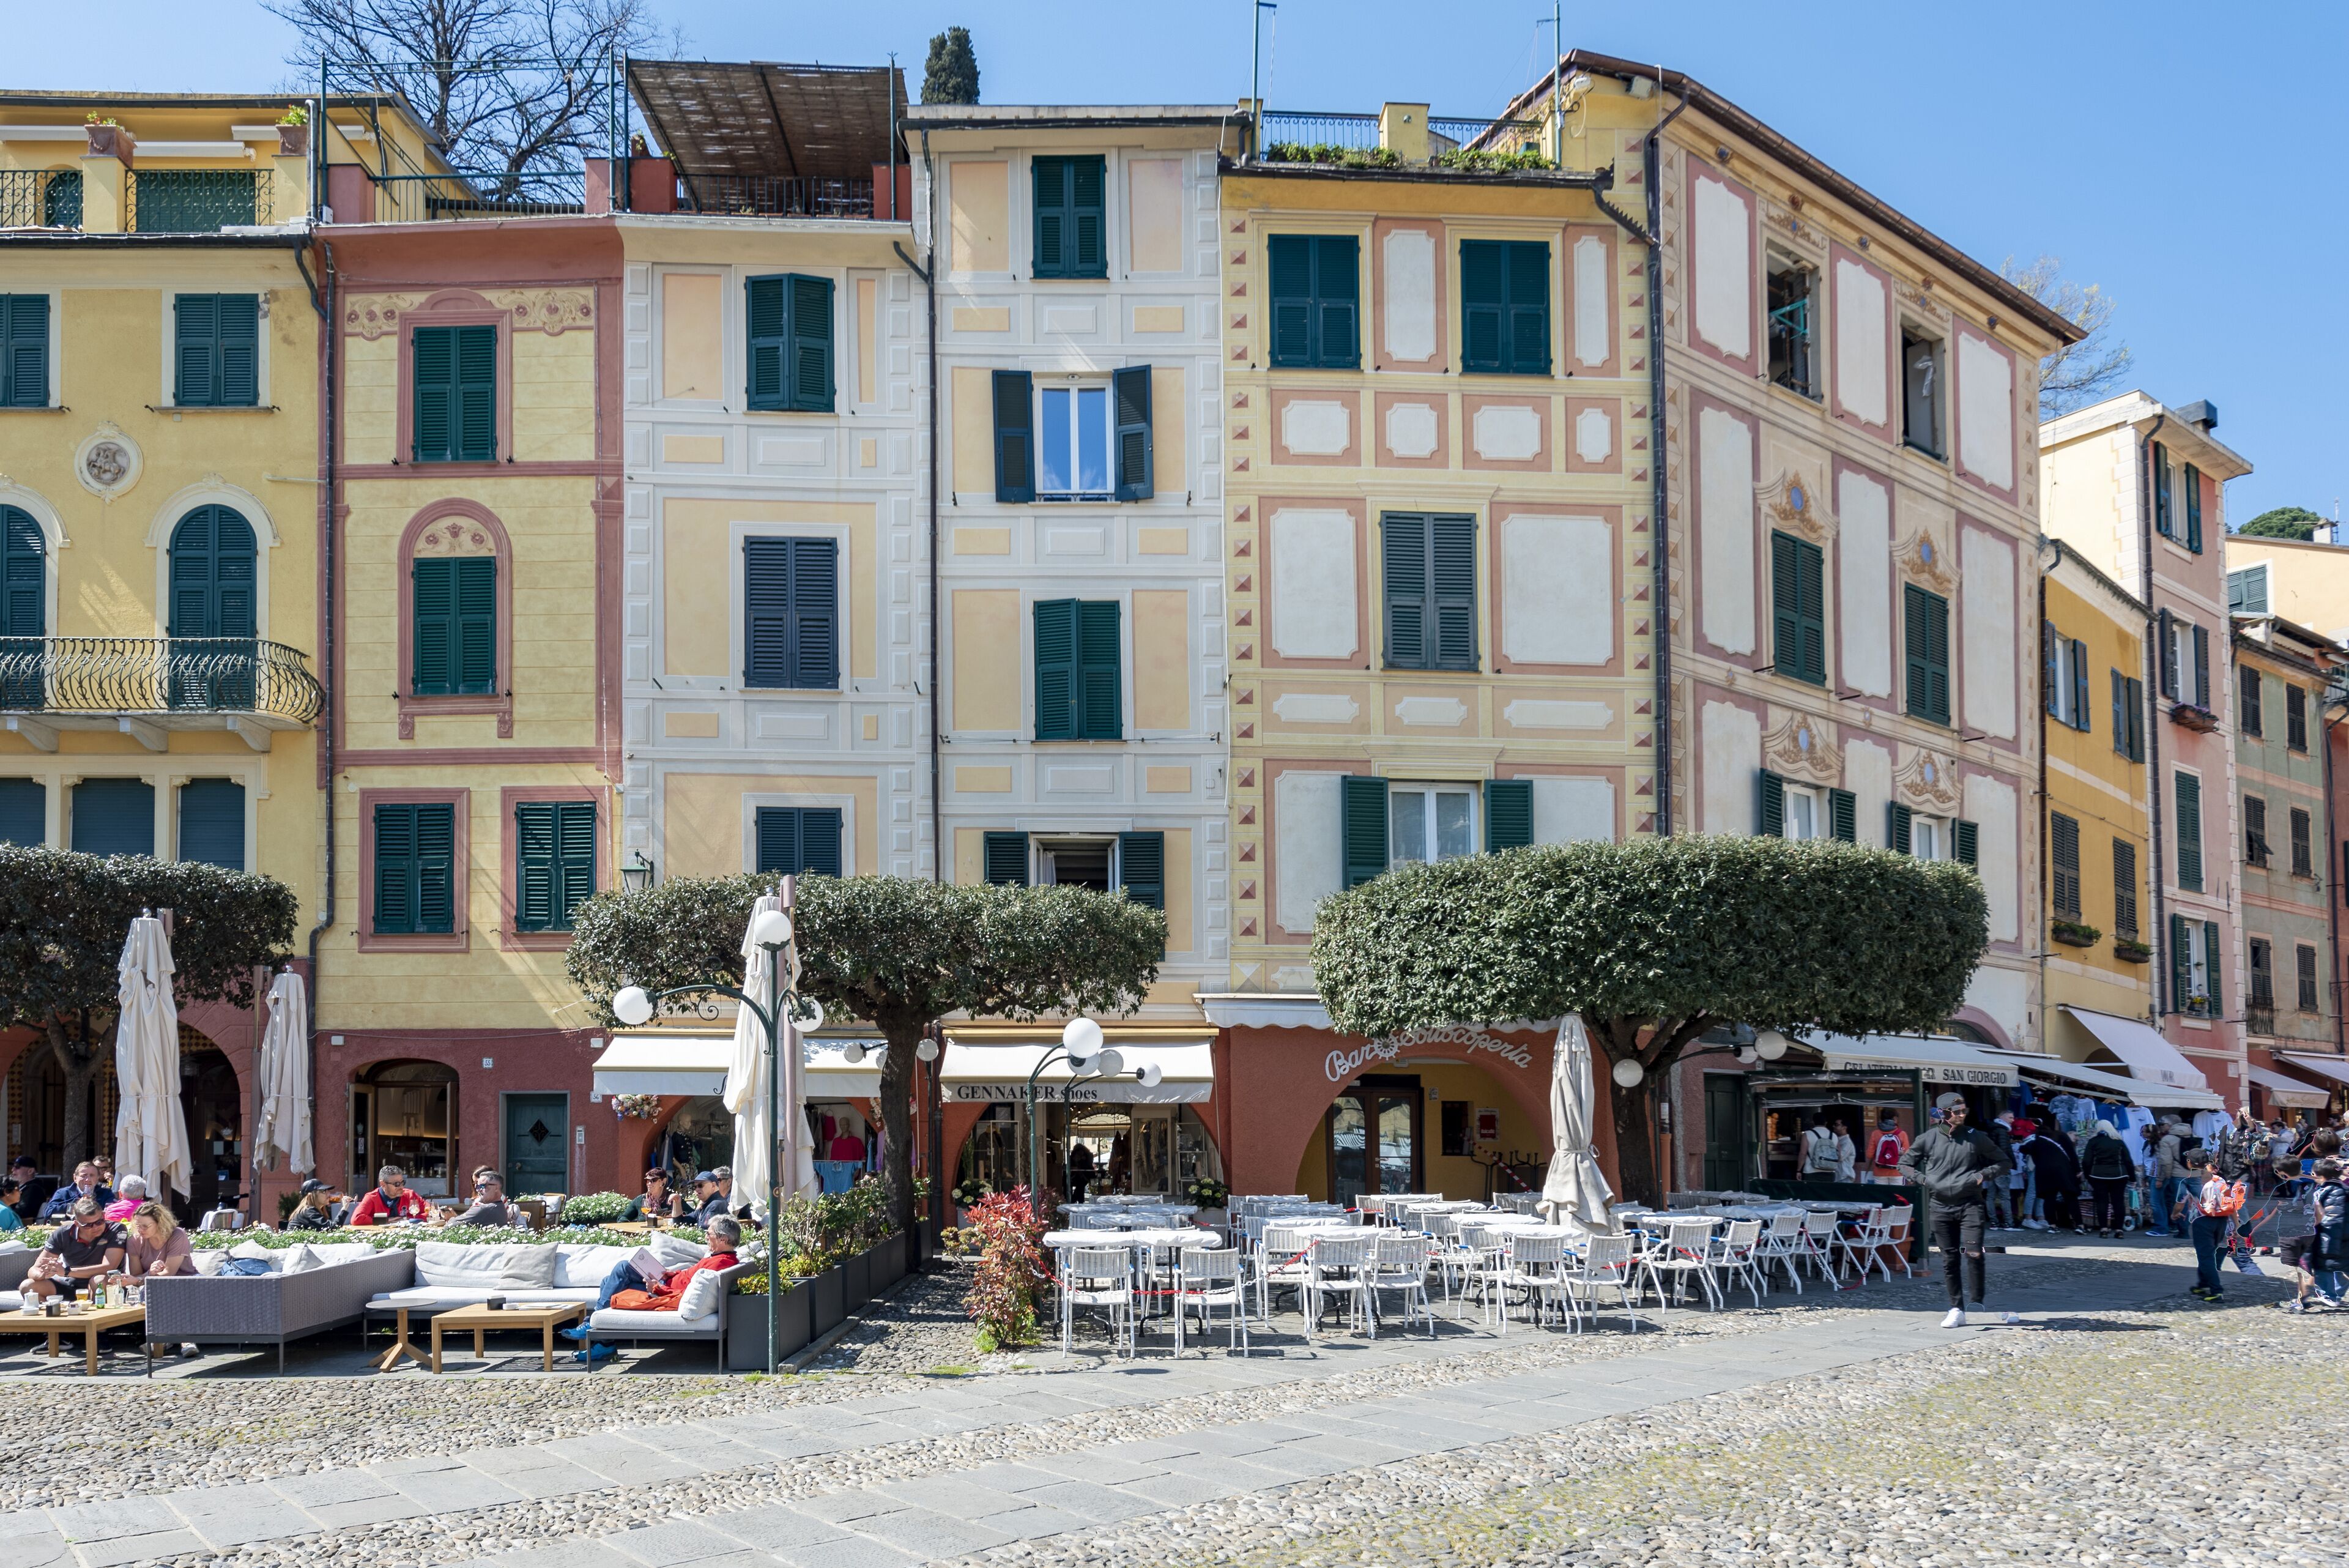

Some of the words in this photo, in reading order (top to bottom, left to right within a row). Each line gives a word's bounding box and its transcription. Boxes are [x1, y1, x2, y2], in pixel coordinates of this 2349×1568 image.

[1325, 1042, 1376, 1082] Bar
[1942, 1068, 1964, 1082] SAN
[1967, 1070, 2008, 1085] GIORGIO
[957, 1085, 1055, 1099] GENNAKER
